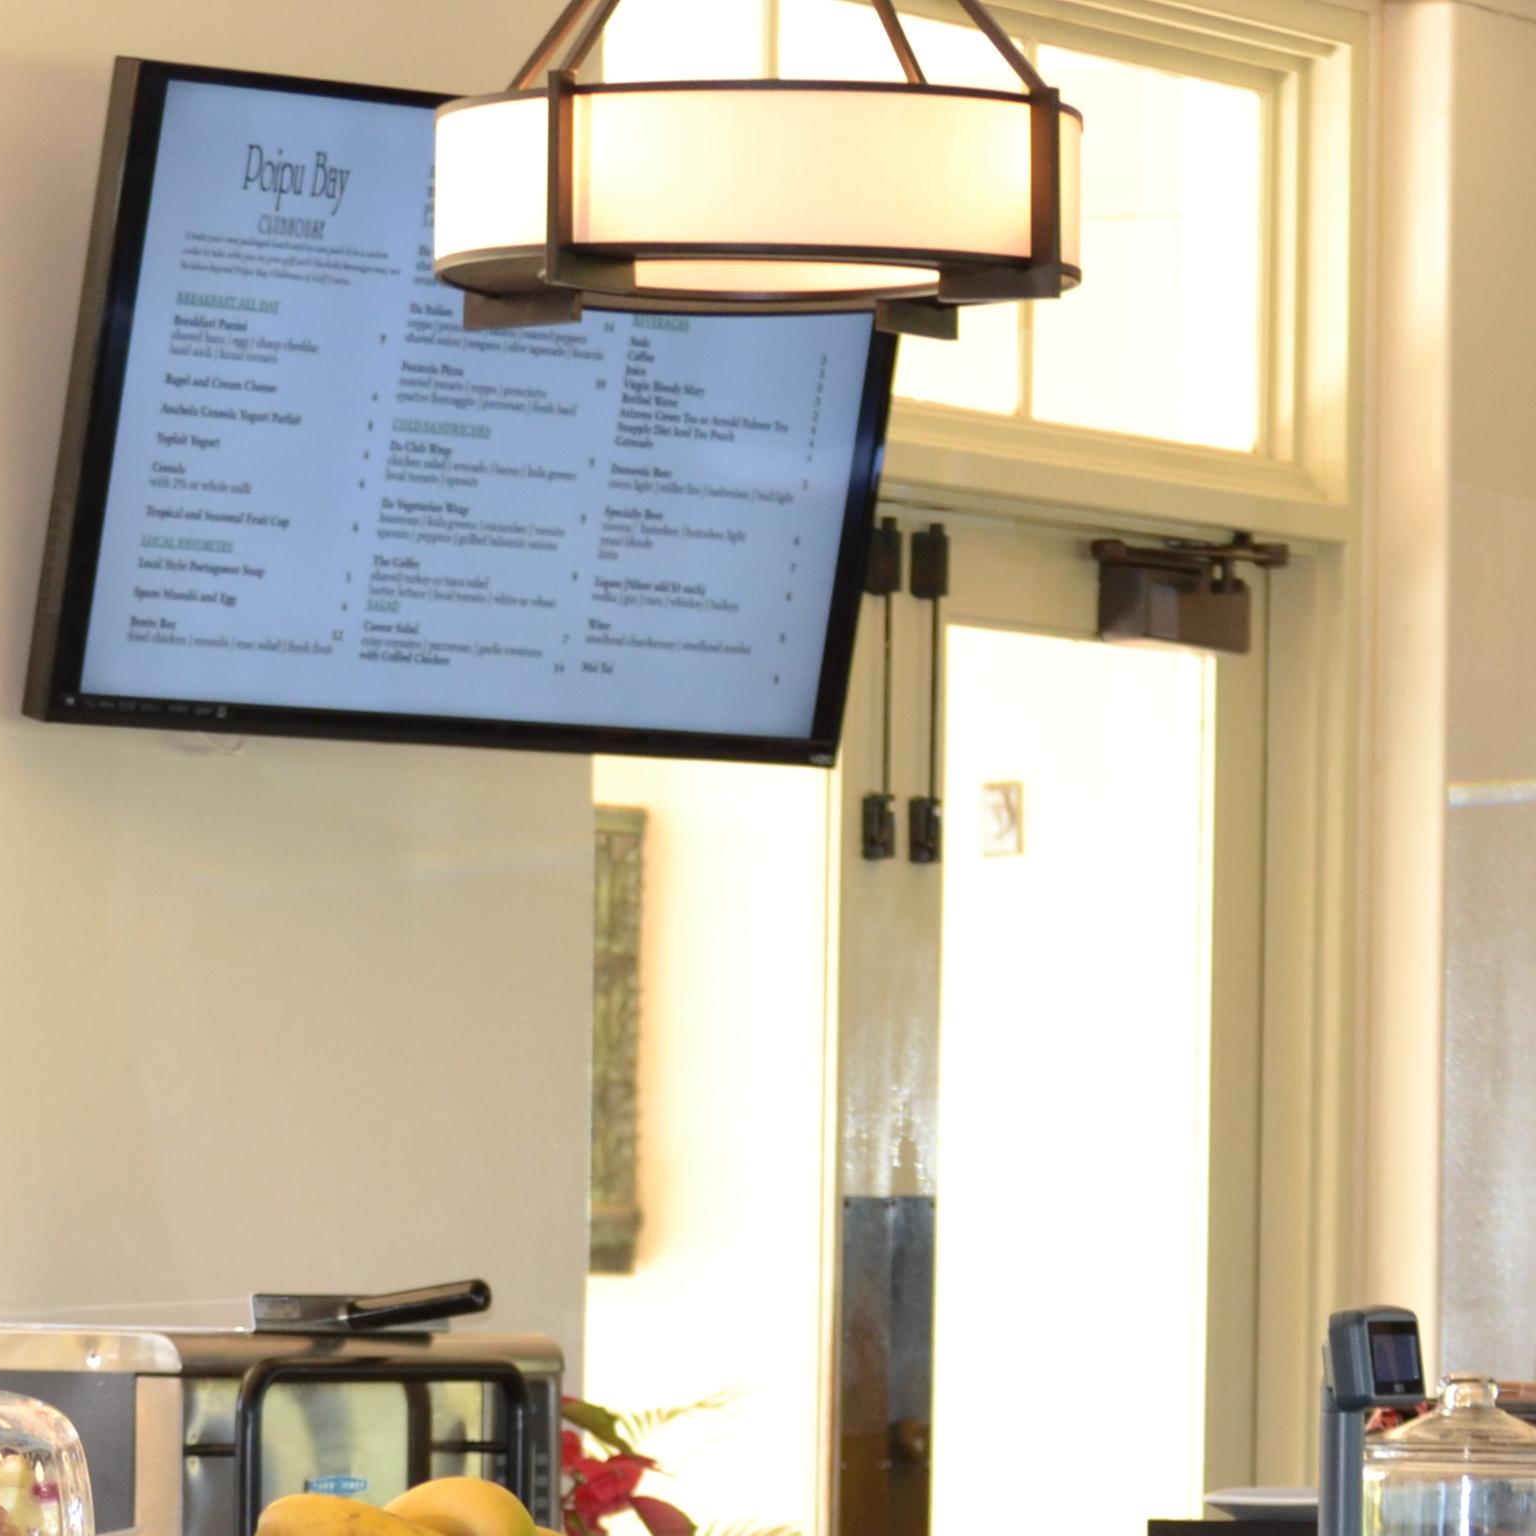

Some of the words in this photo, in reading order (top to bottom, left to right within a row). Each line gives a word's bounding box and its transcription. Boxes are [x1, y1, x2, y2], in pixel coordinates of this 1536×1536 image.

[242, 144, 305, 211] Poipu
[311, 151, 350, 215] Bay
[176, 292, 237, 312] BREAKFAST
[174, 315, 215, 329] Breakfast
[166, 374, 190, 387] Bagel
[192, 377, 210, 388] and
[212, 378, 243, 390] Cream
[245, 381, 276, 394] Cheese
[190, 435, 220, 449] Yogurt
[146, 504, 184, 521] Tropical
[186, 510, 202, 521] and
